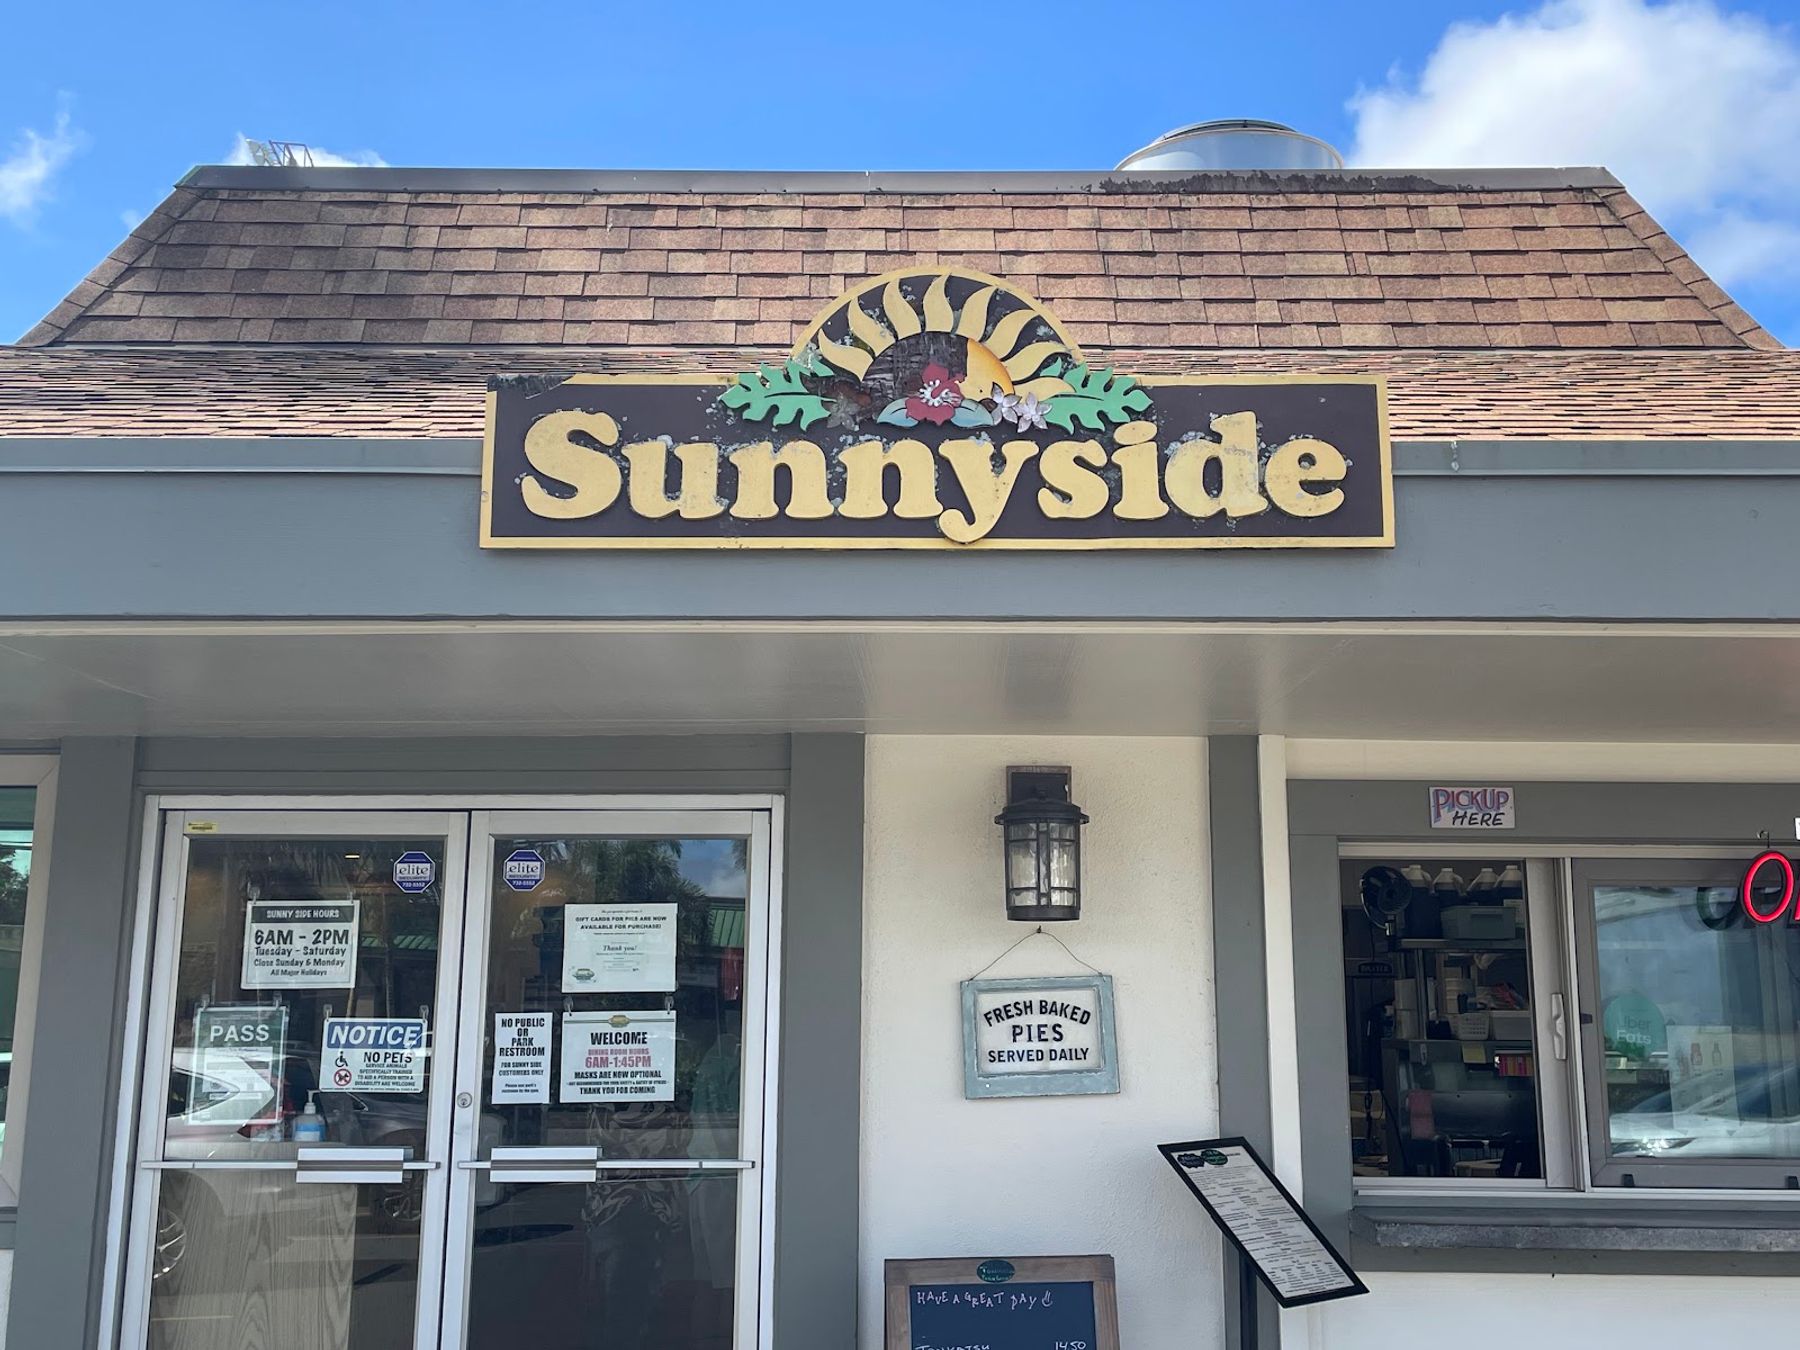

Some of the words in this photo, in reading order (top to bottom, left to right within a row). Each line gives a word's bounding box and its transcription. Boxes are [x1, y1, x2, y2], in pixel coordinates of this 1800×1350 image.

[521, 409, 1346, 545] Sunnyside
[1432, 789, 1510, 823] PICKUP
[1452, 811, 1505, 826] HERE
[399, 864, 428, 875] elite
[510, 862, 538, 873] elite
[266, 909, 293, 919] SUNNY
[294, 909, 312, 918] SIDE
[313, 909, 340, 918] HOURS
[254, 929, 294, 945] 6AM
[312, 929, 349, 945] 2PM
[255, 947, 293, 957] Tuesday
[303, 946, 347, 957] Saturday
[254, 958, 273, 967] Close
[275, 958, 304, 968] Sunday
[313, 958, 345, 968] Monday
[281, 969, 299, 977] Major
[984, 1000, 1033, 1027] FRESH
[1039, 1000, 1091, 1025] BAKED
[501, 1018, 513, 1028] NO
[515, 1018, 545, 1027] PUBLIC
[210, 1024, 270, 1042] PASS
[330, 1025, 421, 1045] NOTICE
[517, 1028, 529, 1037] OR
[1012, 1023, 1064, 1042] PIES
[512, 1037, 534, 1046] PARK
[591, 1032, 648, 1045] WELCOME
[499, 1047, 545, 1056] RESTROOM
[588, 1048, 609, 1056] DINING
[610, 1048, 628, 1056] ROOM
[988, 1049, 1044, 1063] SERVED
[1049, 1048, 1089, 1061] DAILY
[364, 1052, 380, 1063] NO
[384, 1052, 412, 1063] PETS
[585, 1056, 651, 1068] 6AM-1:45PM
[574, 1071, 599, 1079] MASKS
[599, 1071, 612, 1079] ARE
[630, 1070, 662, 1078] OPTIONAL
[629, 1086, 656, 1094] COMING
[917, 1291, 949, 1305] HAVE
[952, 1294, 960, 1304] A
[964, 1292, 1004, 1308] GREAT
[1011, 1293, 1037, 1310] DAY
